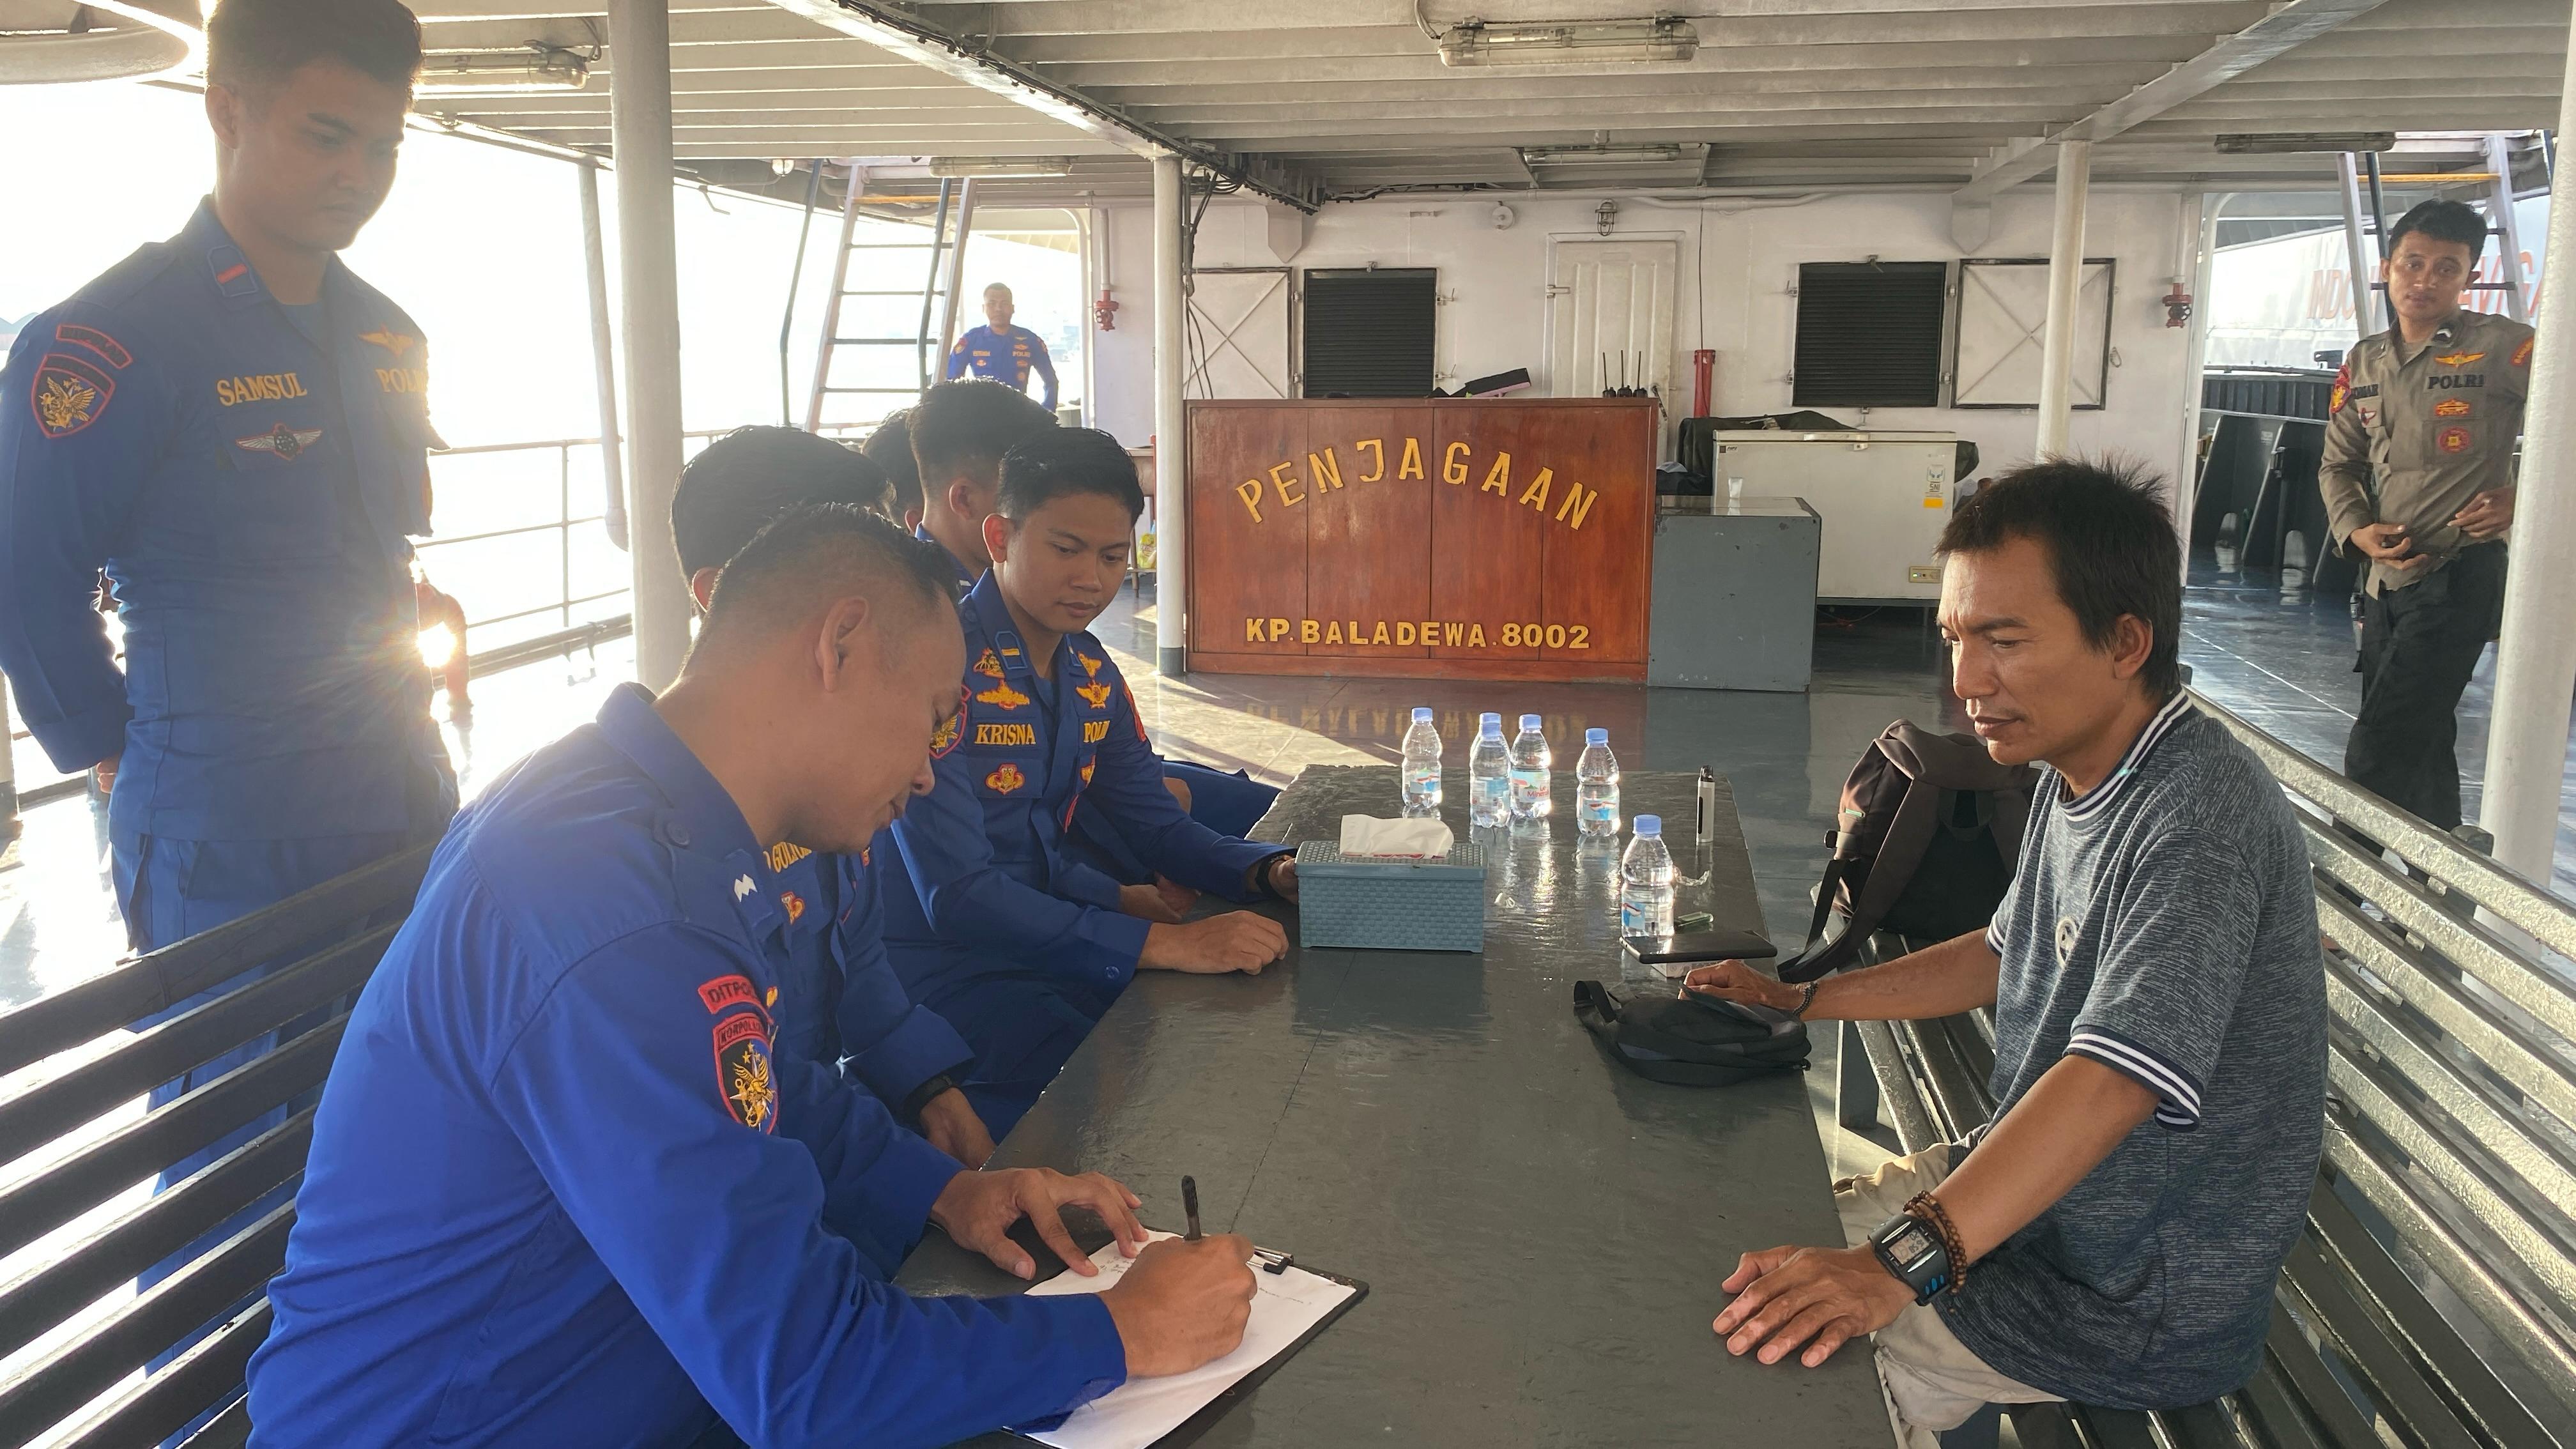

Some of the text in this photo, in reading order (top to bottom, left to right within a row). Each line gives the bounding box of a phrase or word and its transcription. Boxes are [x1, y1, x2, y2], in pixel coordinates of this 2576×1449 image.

[217, 372, 308, 406] SAMSUL
[2428, 374, 2485, 389] POLRI
[1236, 438, 1598, 531] PENJAGAAN
[1501, 623, 1590, 649] 8002
[974, 723, 1036, 746] KRISNA
